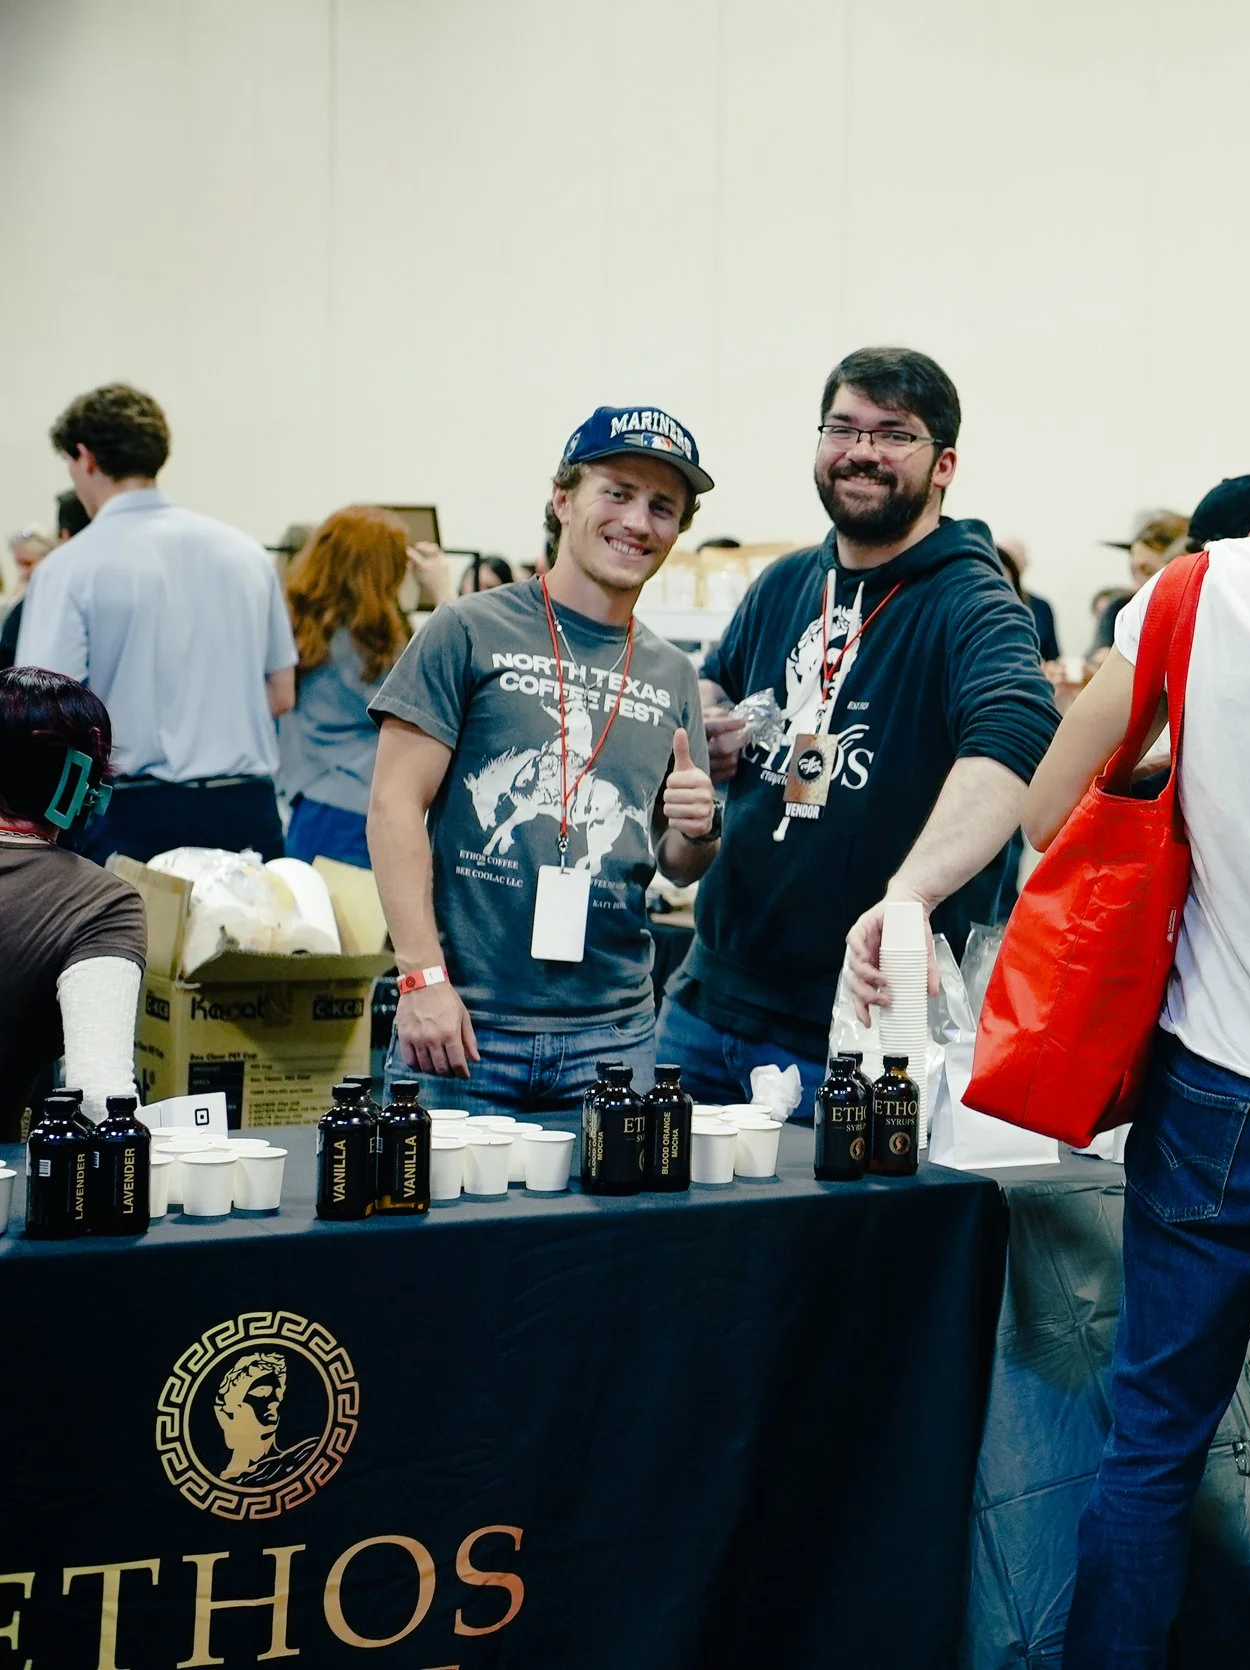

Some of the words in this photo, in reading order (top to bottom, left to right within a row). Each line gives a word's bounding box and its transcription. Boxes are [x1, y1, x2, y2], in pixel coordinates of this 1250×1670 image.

[610, 411, 692, 461] MARINERS
[491, 653, 587, 683] NORTH
[590, 667, 671, 708] TEXAS
[499, 671, 601, 710] COFFEE
[603, 693, 664, 727] FEST
[785, 802, 820, 820] VENDOR
[486, 855, 519, 870] COFFEE
[662, 1111, 671, 1146] ORANGE
[671, 1128, 679, 1158] MOCHA
[75, 1153, 86, 1220] LAVENDER
[123, 1147, 136, 1214] LAVENDER
[333, 1139, 346, 1203] VANILLA
[403, 1135, 417, 1198] VANILLA
[661, 1147, 670, 1175] BLOOD
